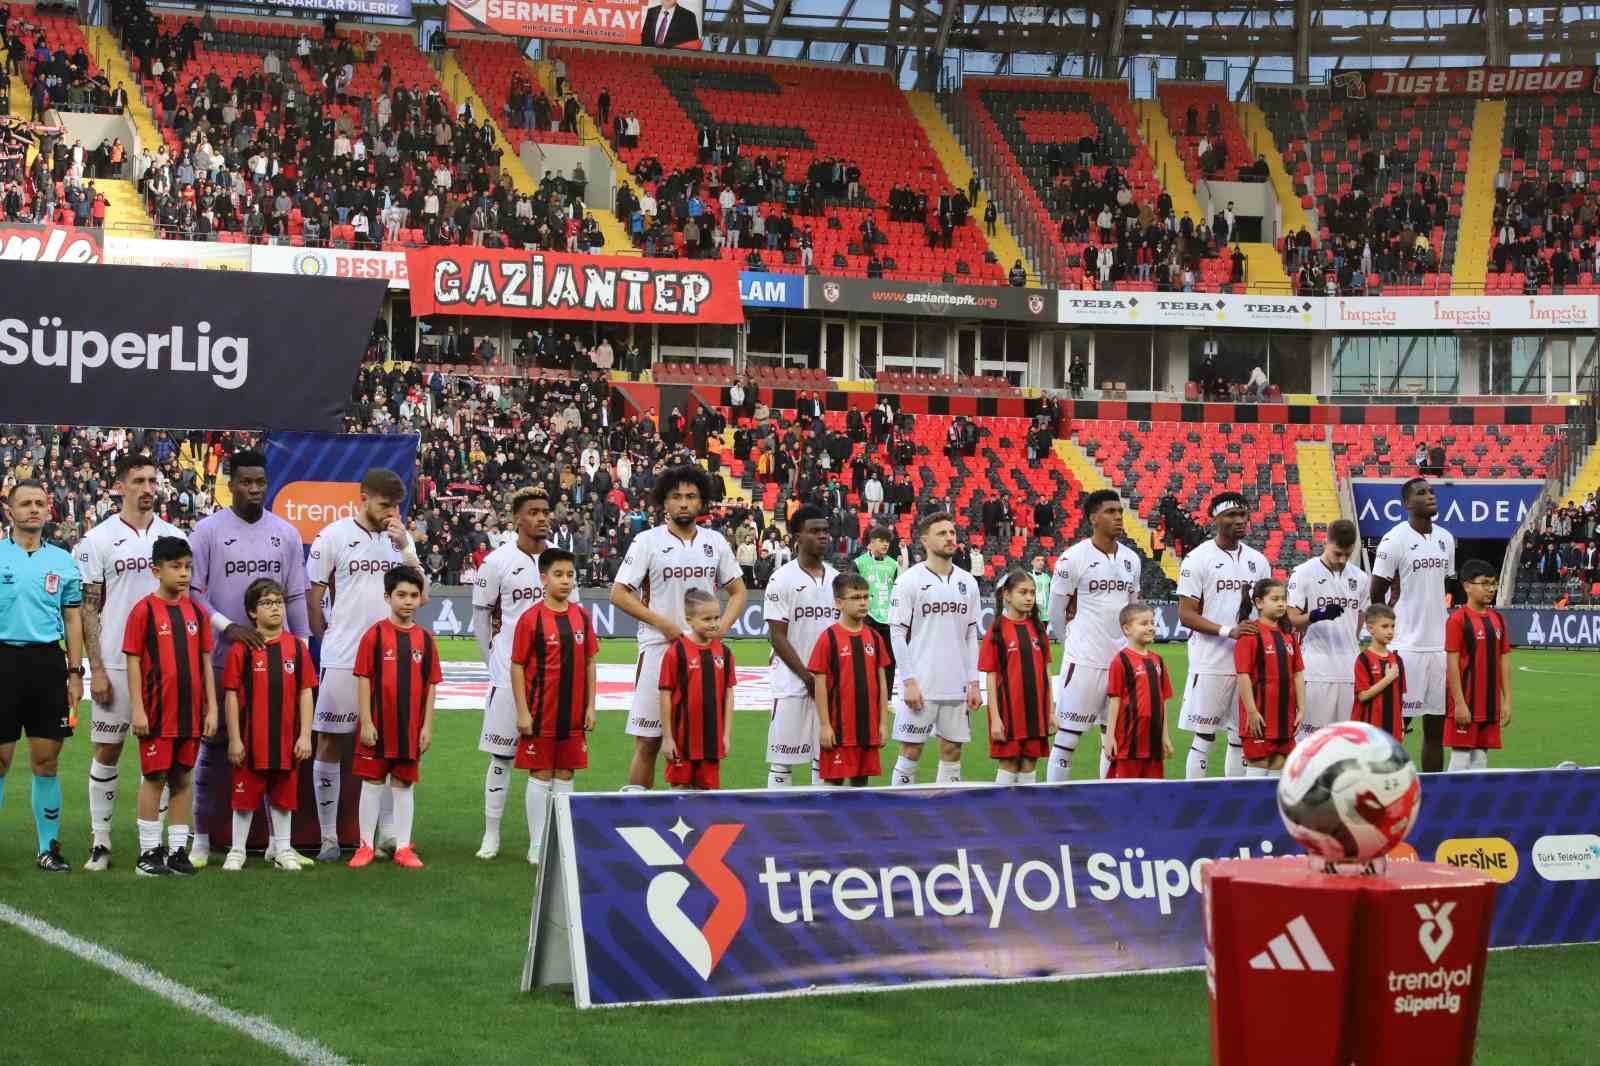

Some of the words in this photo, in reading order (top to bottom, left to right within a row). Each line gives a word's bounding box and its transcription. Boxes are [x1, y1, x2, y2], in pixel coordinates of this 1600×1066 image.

[487, 0, 577, 24] SERMET
[582, 7, 641, 29] ATAY
[1376, 71, 1451, 94] Just
[1465, 69, 1584, 93] Believe
[0, 228, 99, 263] nle
[432, 254, 712, 315] GAZİANTEP
[871, 290, 999, 308] www.gaziantepfk.org
[1069, 299, 1126, 309] TEBA
[1157, 301, 1213, 312] TEBA
[1244, 304, 1300, 314] TEBA
[0, 316, 249, 389] SüperLig
[285, 499, 359, 521] trend
[225, 559, 281, 577] papara
[349, 559, 403, 576] papar
[662, 565, 717, 582] papara
[512, 584, 546, 602] papa
[1088, 579, 1135, 593] papara
[794, 605, 841, 622] papara
[922, 601, 968, 617] papara
[1537, 852, 1556, 862] Türk
[1557, 851, 1592, 861] Telekom
[758, 844, 1077, 929] trendyol
[1387, 964, 1472, 996] trendyol
[1394, 990, 1461, 1016] SüperLig
